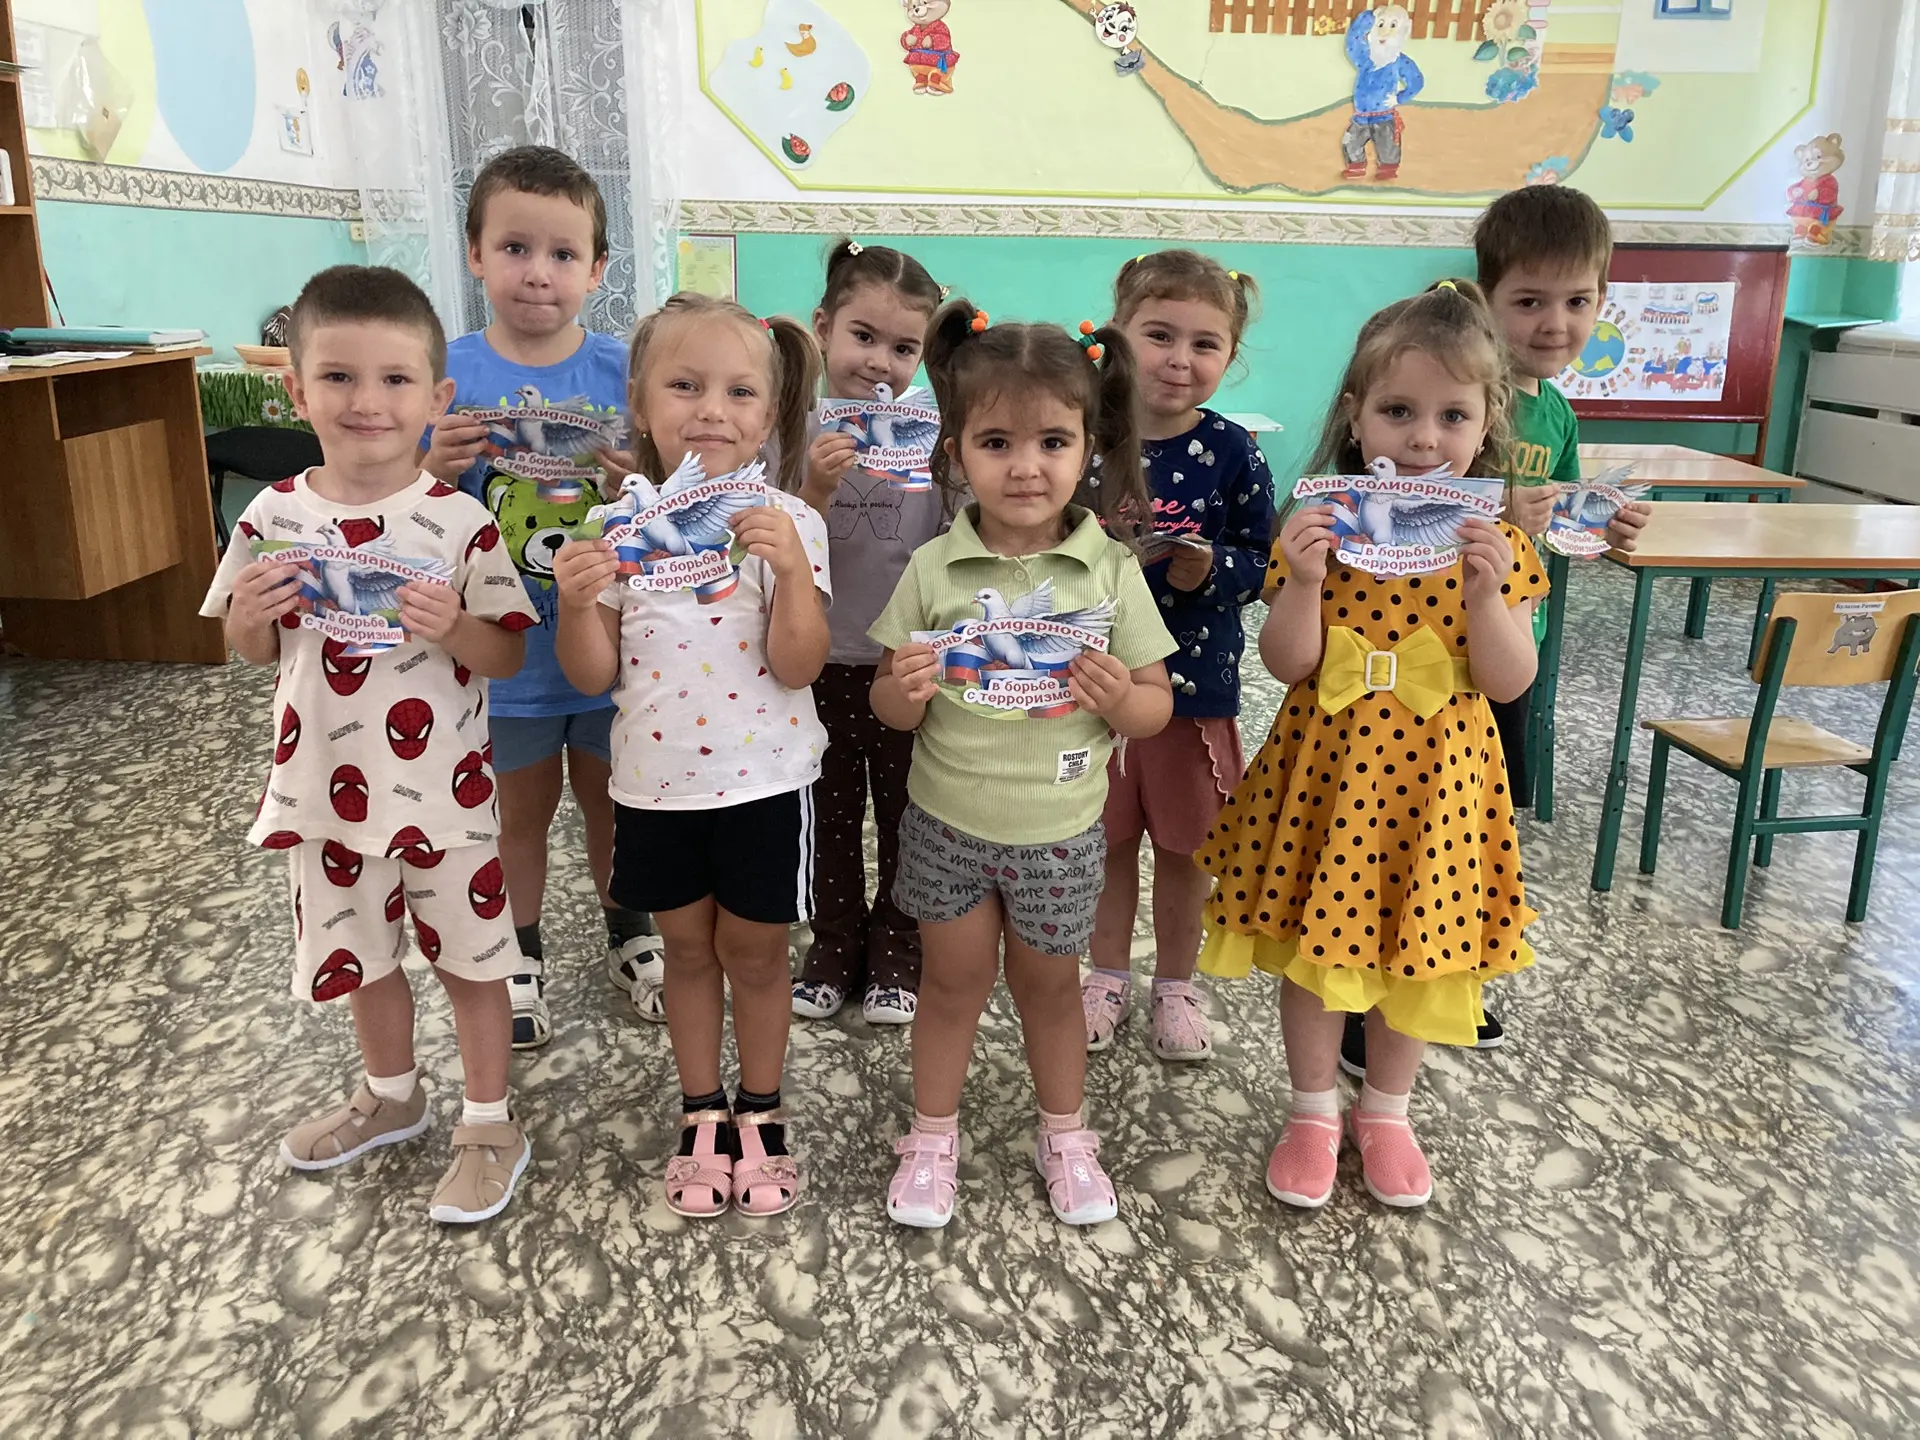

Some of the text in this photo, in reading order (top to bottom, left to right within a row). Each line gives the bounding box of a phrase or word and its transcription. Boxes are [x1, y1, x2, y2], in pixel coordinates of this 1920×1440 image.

[822, 406, 861, 421] День
[518, 454, 572, 467] в борьбе
[863, 456, 930, 468] терроризм
[881, 447, 922, 459] борьбе
[635, 480, 767, 526] солидарности
[1297, 478, 1495, 513] День солидарности
[271, 515, 304, 535] MARVEL
[410, 511, 446, 540] MARVEL
[657, 552, 718, 574] в борьбе
[1339, 551, 1457, 571] с терроризмом
[1365, 546, 1431, 562] в борьбе
[314, 547, 448, 586] солидарности
[484, 574, 517, 589] MARVEL
[632, 577, 642, 587] с
[304, 617, 402, 641] с терроризмом
[329, 611, 385, 629] в борьбе
[927, 620, 1106, 650] ень солидарности
[967, 689, 1072, 706] с терроризмо
[992, 679, 1056, 696] в борьбе
[328, 720, 364, 741] MARVEL
[392, 783, 422, 803] MARVEL
[472, 936, 510, 963] MARVEL
